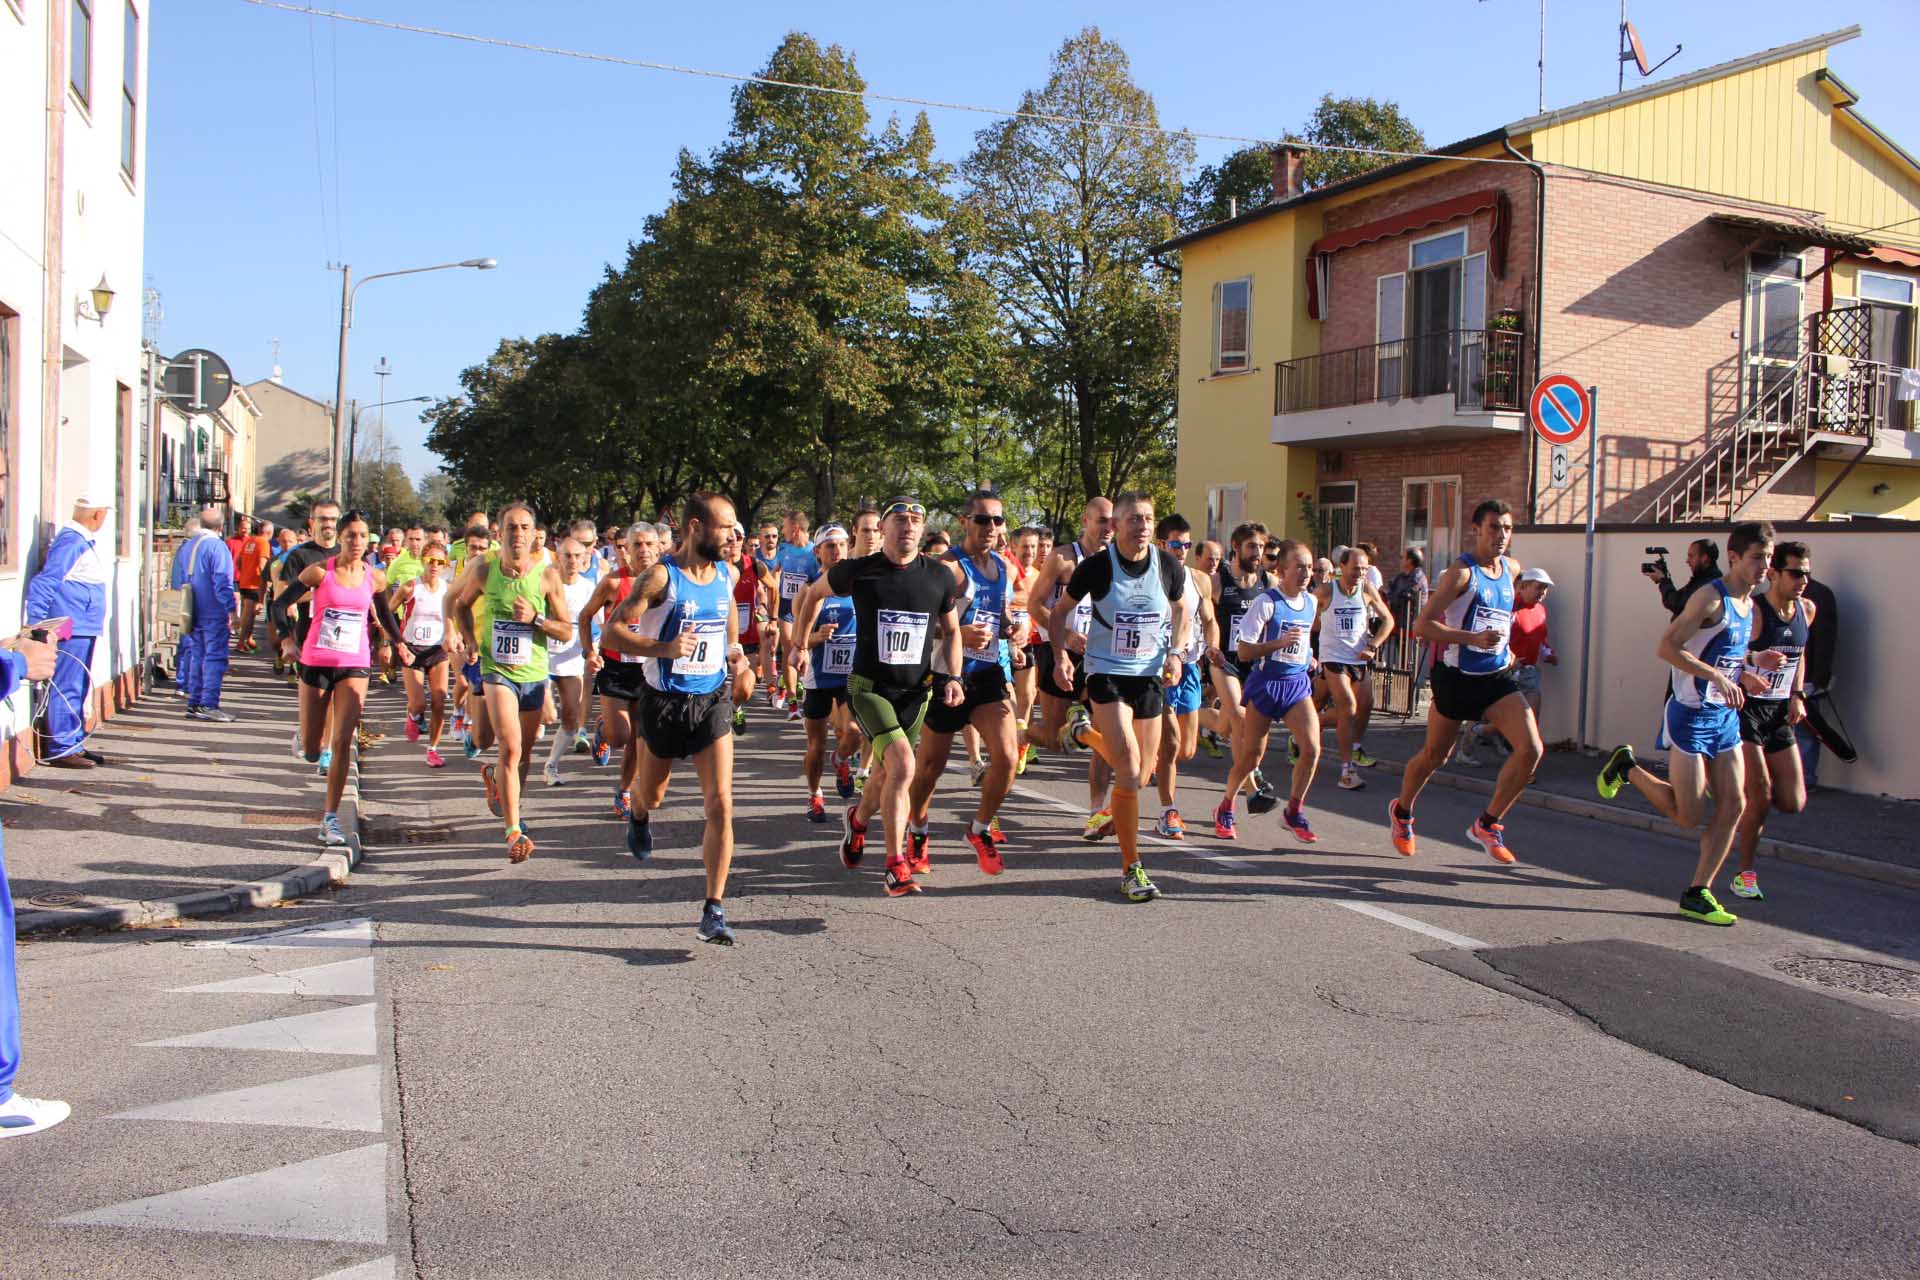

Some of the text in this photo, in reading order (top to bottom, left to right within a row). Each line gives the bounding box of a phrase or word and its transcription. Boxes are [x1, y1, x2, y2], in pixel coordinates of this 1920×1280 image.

[1341, 618, 1353, 630] 161
[496, 635, 520, 655] 289
[885, 630, 910, 652] 100
[1125, 629, 1140, 649] 15
[831, 649, 851, 666] 162
